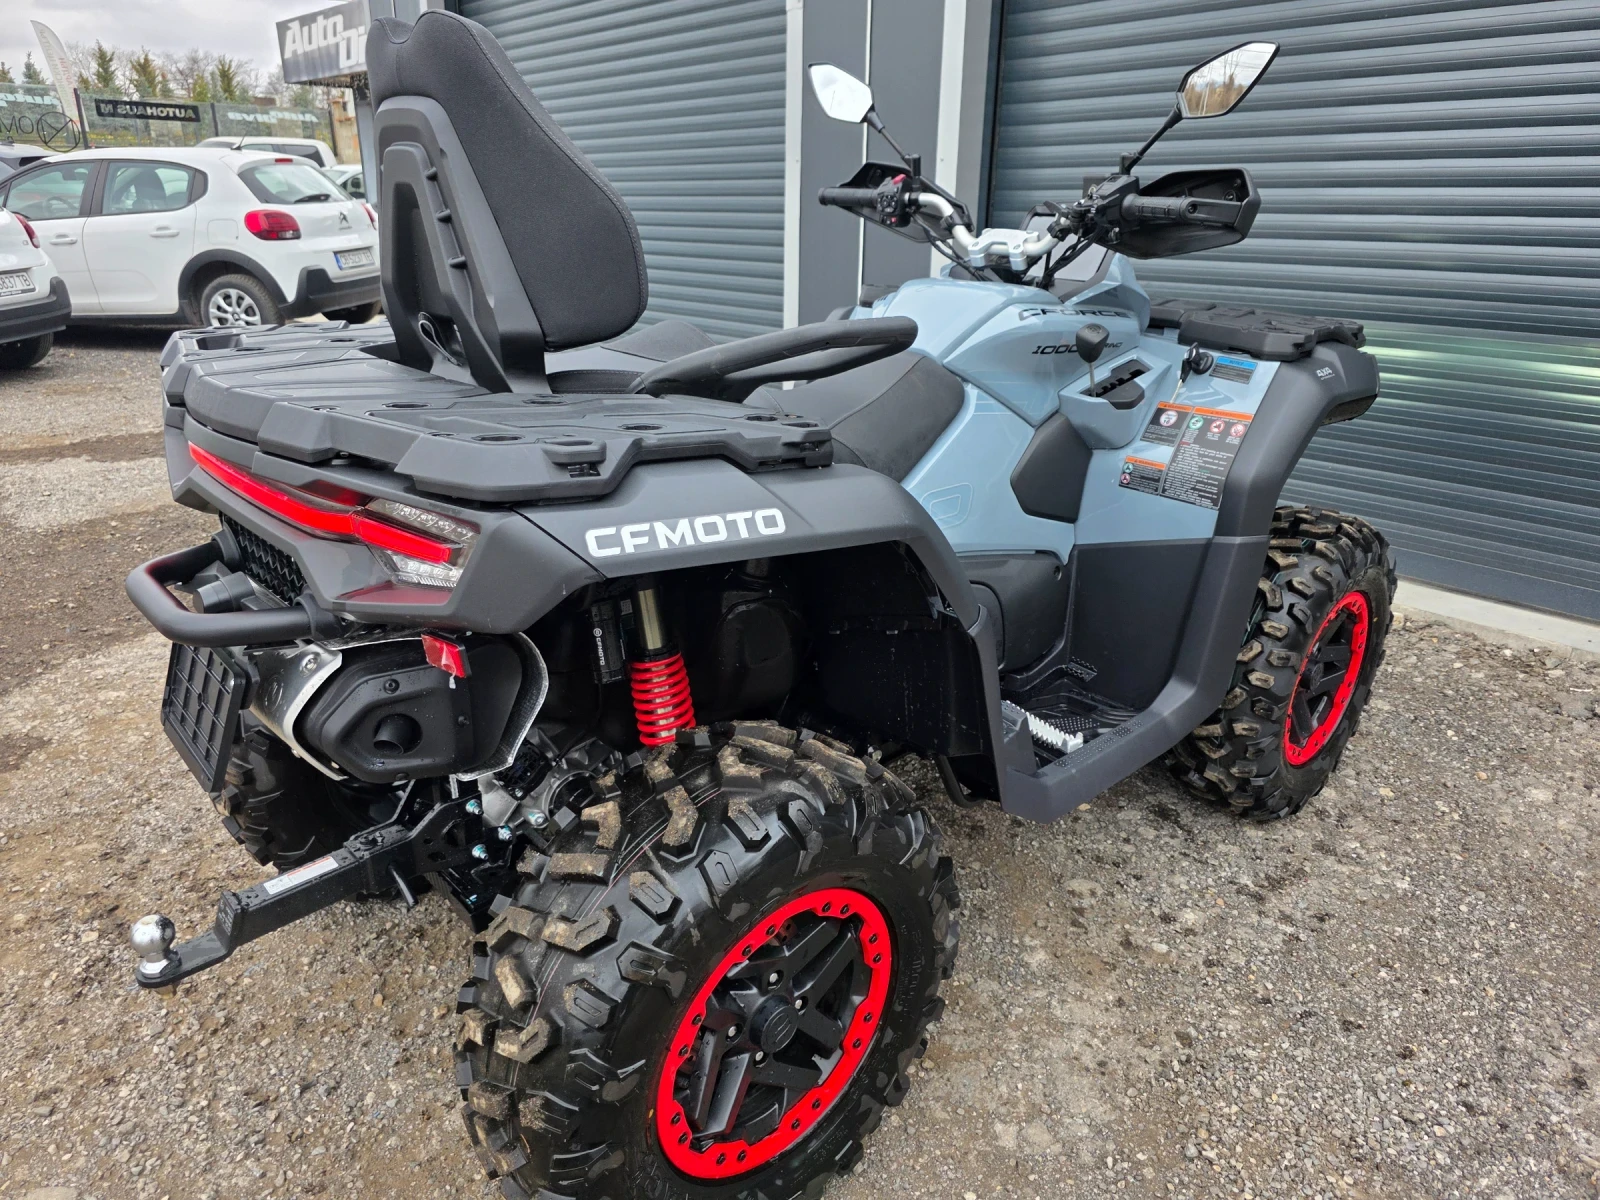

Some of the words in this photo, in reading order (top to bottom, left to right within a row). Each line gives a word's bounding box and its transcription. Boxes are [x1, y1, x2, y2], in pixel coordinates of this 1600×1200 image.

[284, 14, 344, 59] Auto
[16, 274, 31, 287] TB
[1018, 308, 1131, 321] CFORCE
[585, 508, 786, 557] CFMOTO
[596, 637, 606, 666] CFMOTO
